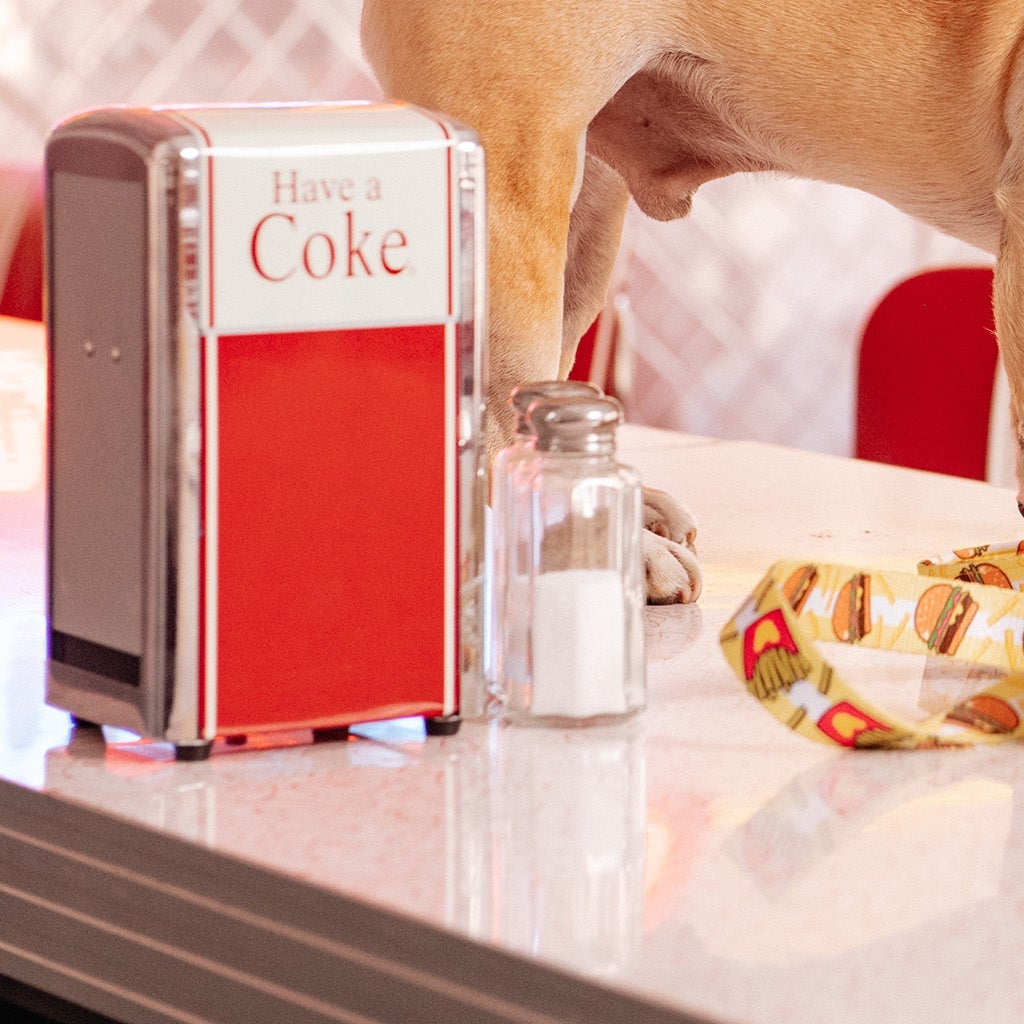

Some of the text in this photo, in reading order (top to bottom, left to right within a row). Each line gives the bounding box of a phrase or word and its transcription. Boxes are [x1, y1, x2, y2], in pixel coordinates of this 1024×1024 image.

[273, 171, 382, 203] Have a
[250, 210, 408, 282] Coke
